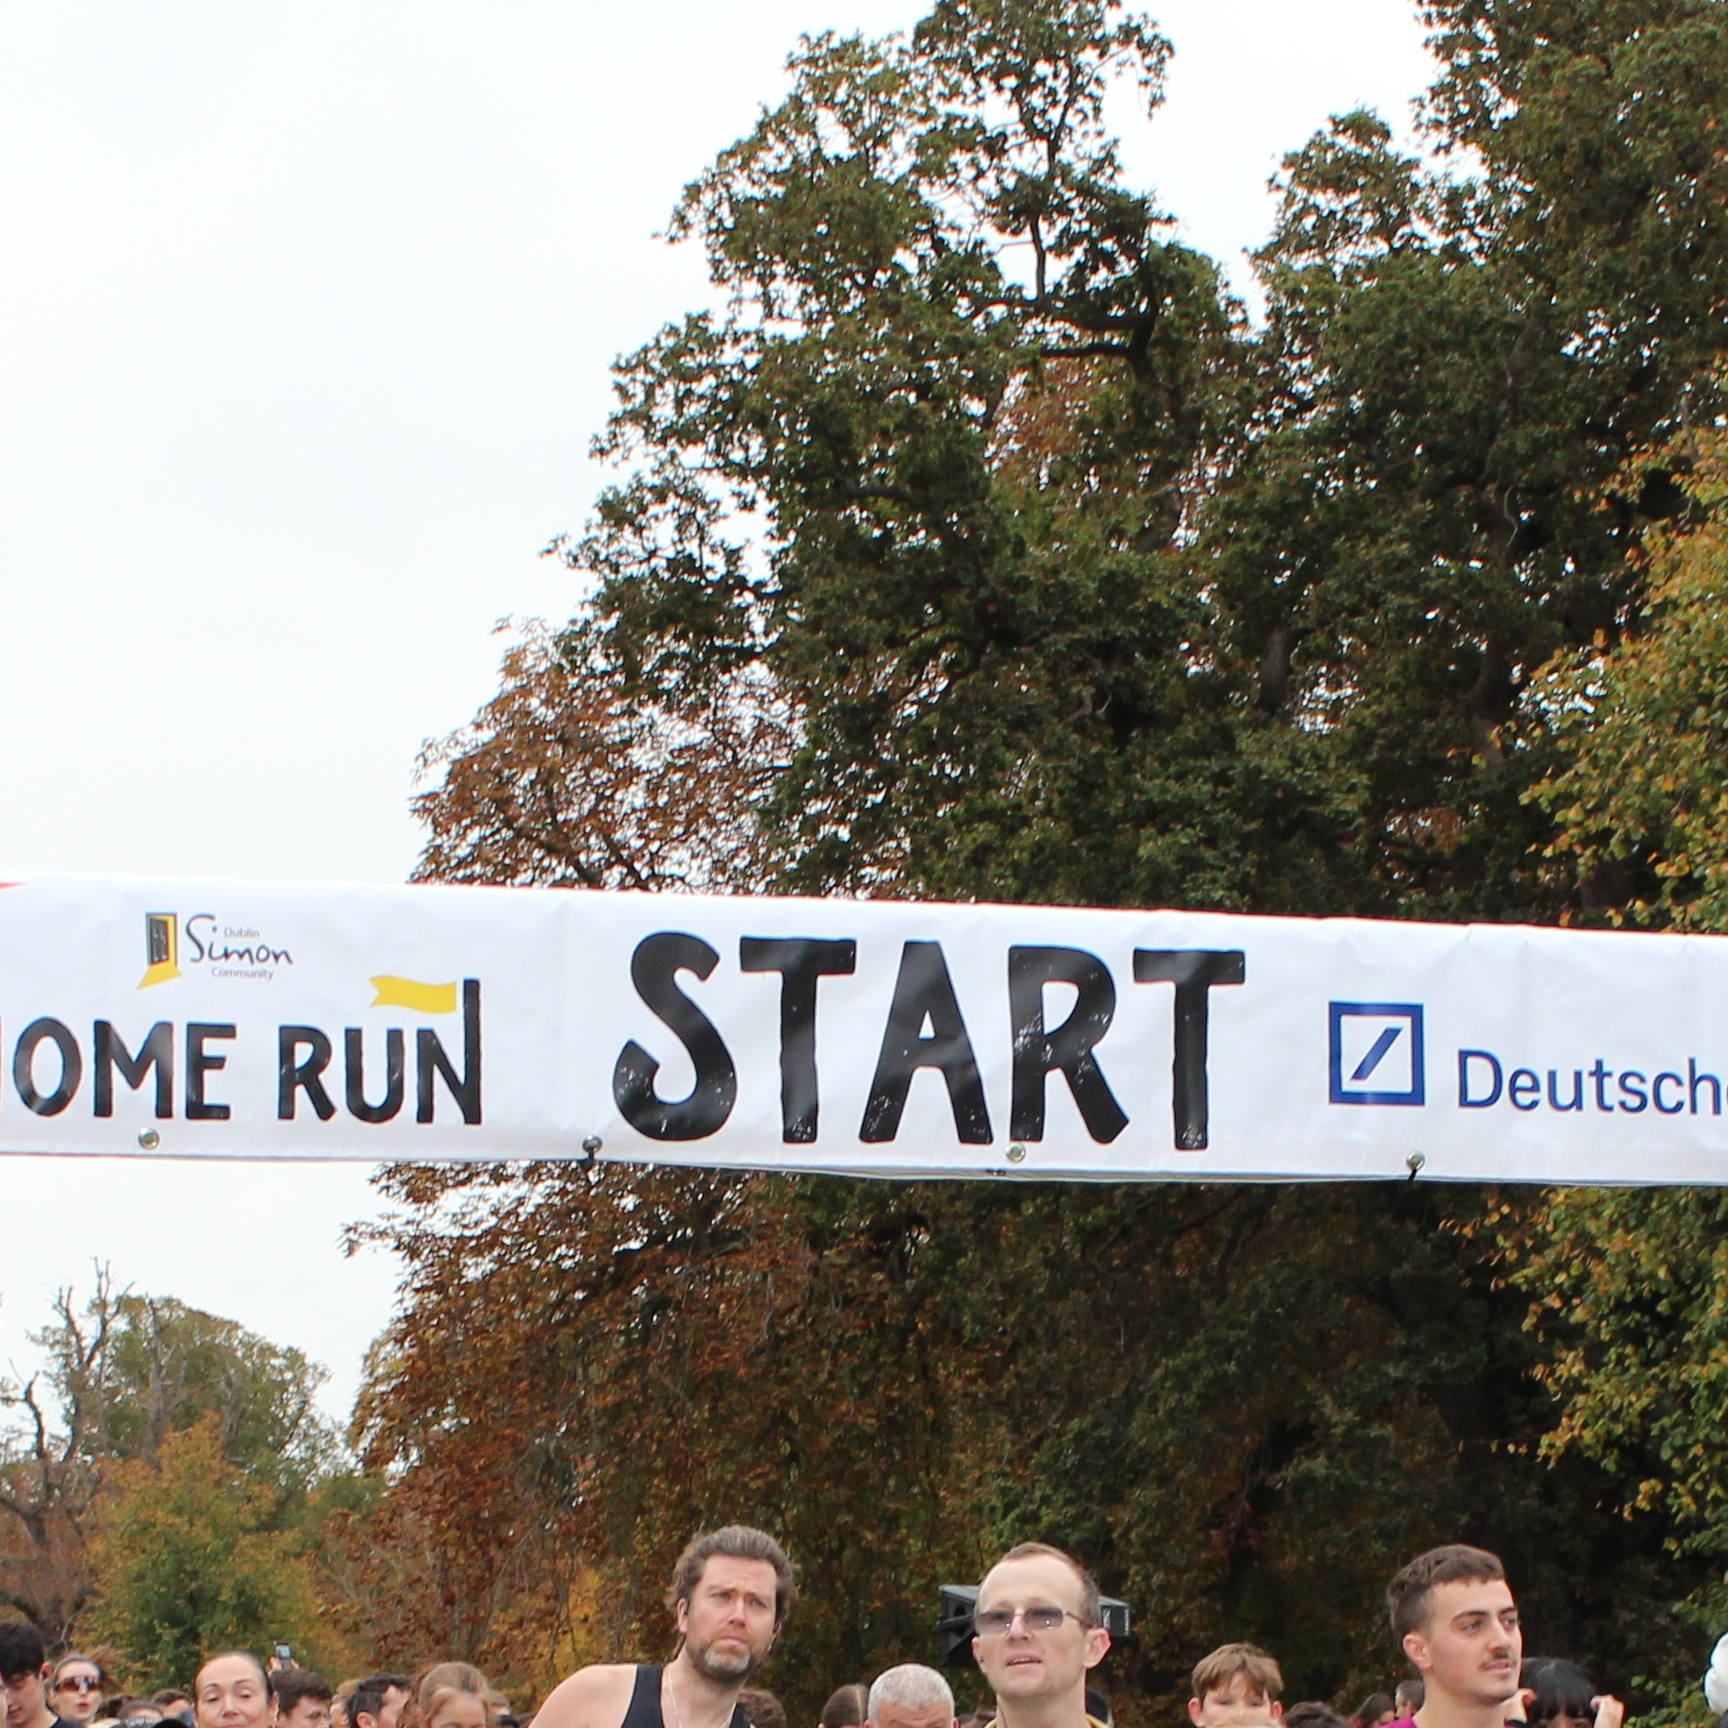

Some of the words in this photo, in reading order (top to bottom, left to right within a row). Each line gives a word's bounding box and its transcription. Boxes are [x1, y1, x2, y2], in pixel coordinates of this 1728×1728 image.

[185, 913, 294, 965] Simon
[223, 925, 261, 939] Dublin
[211, 966, 274, 981] Community
[278, 978, 482, 1125] RUN
[612, 931, 1246, 1151] START
